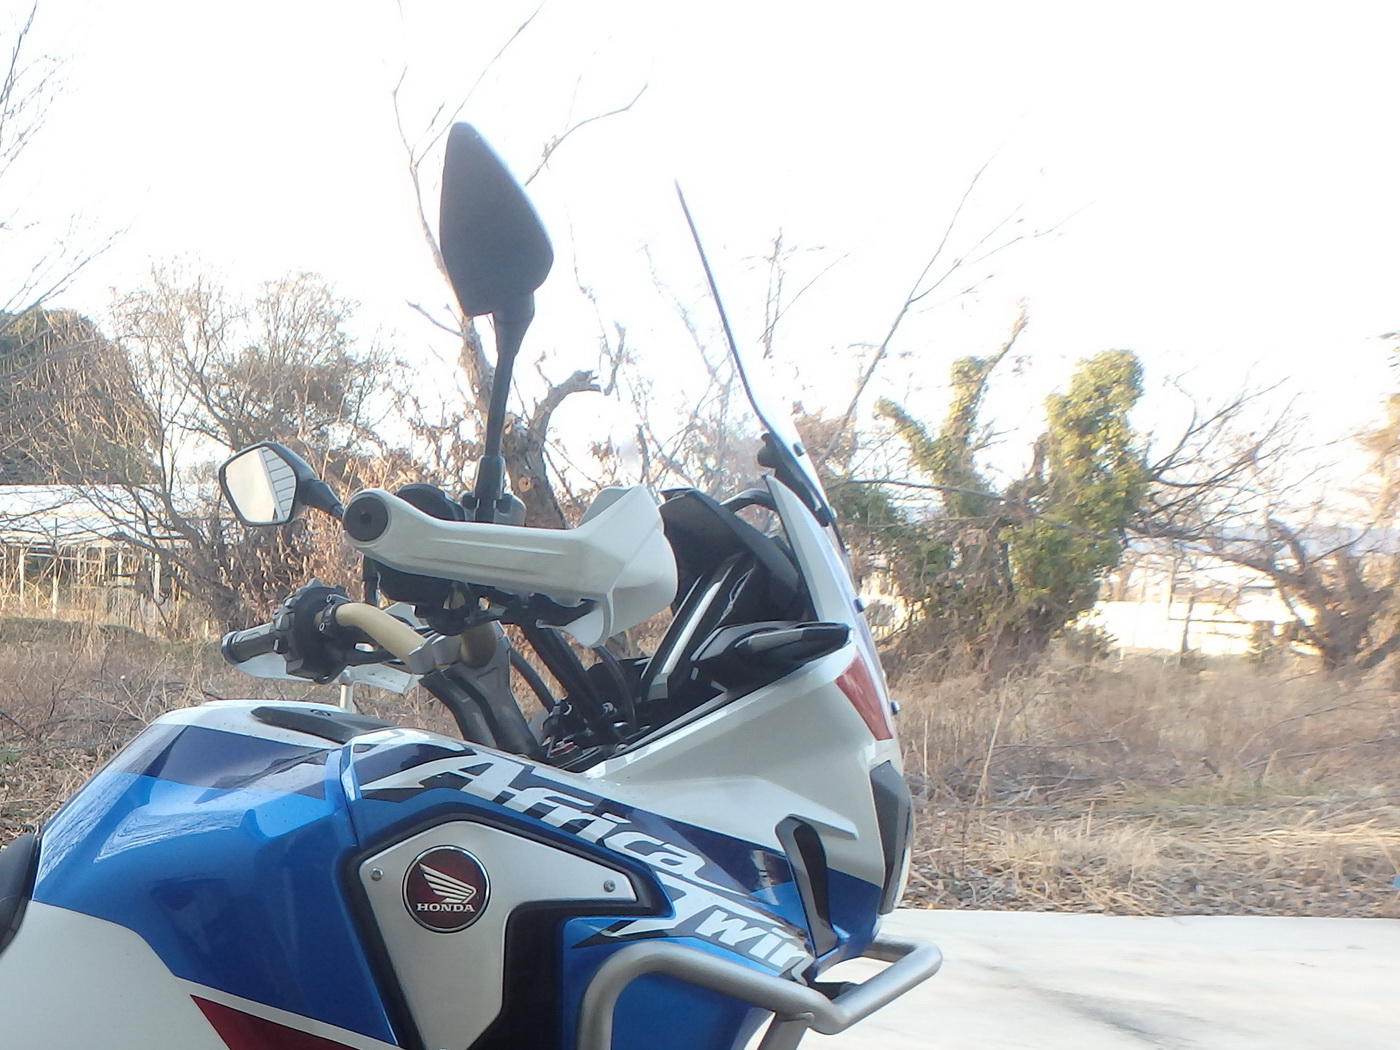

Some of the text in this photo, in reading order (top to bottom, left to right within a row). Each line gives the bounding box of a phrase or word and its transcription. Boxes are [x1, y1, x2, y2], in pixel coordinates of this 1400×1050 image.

[361, 754, 814, 986] Africa Twin
[416, 903, 476, 913] HONDA
